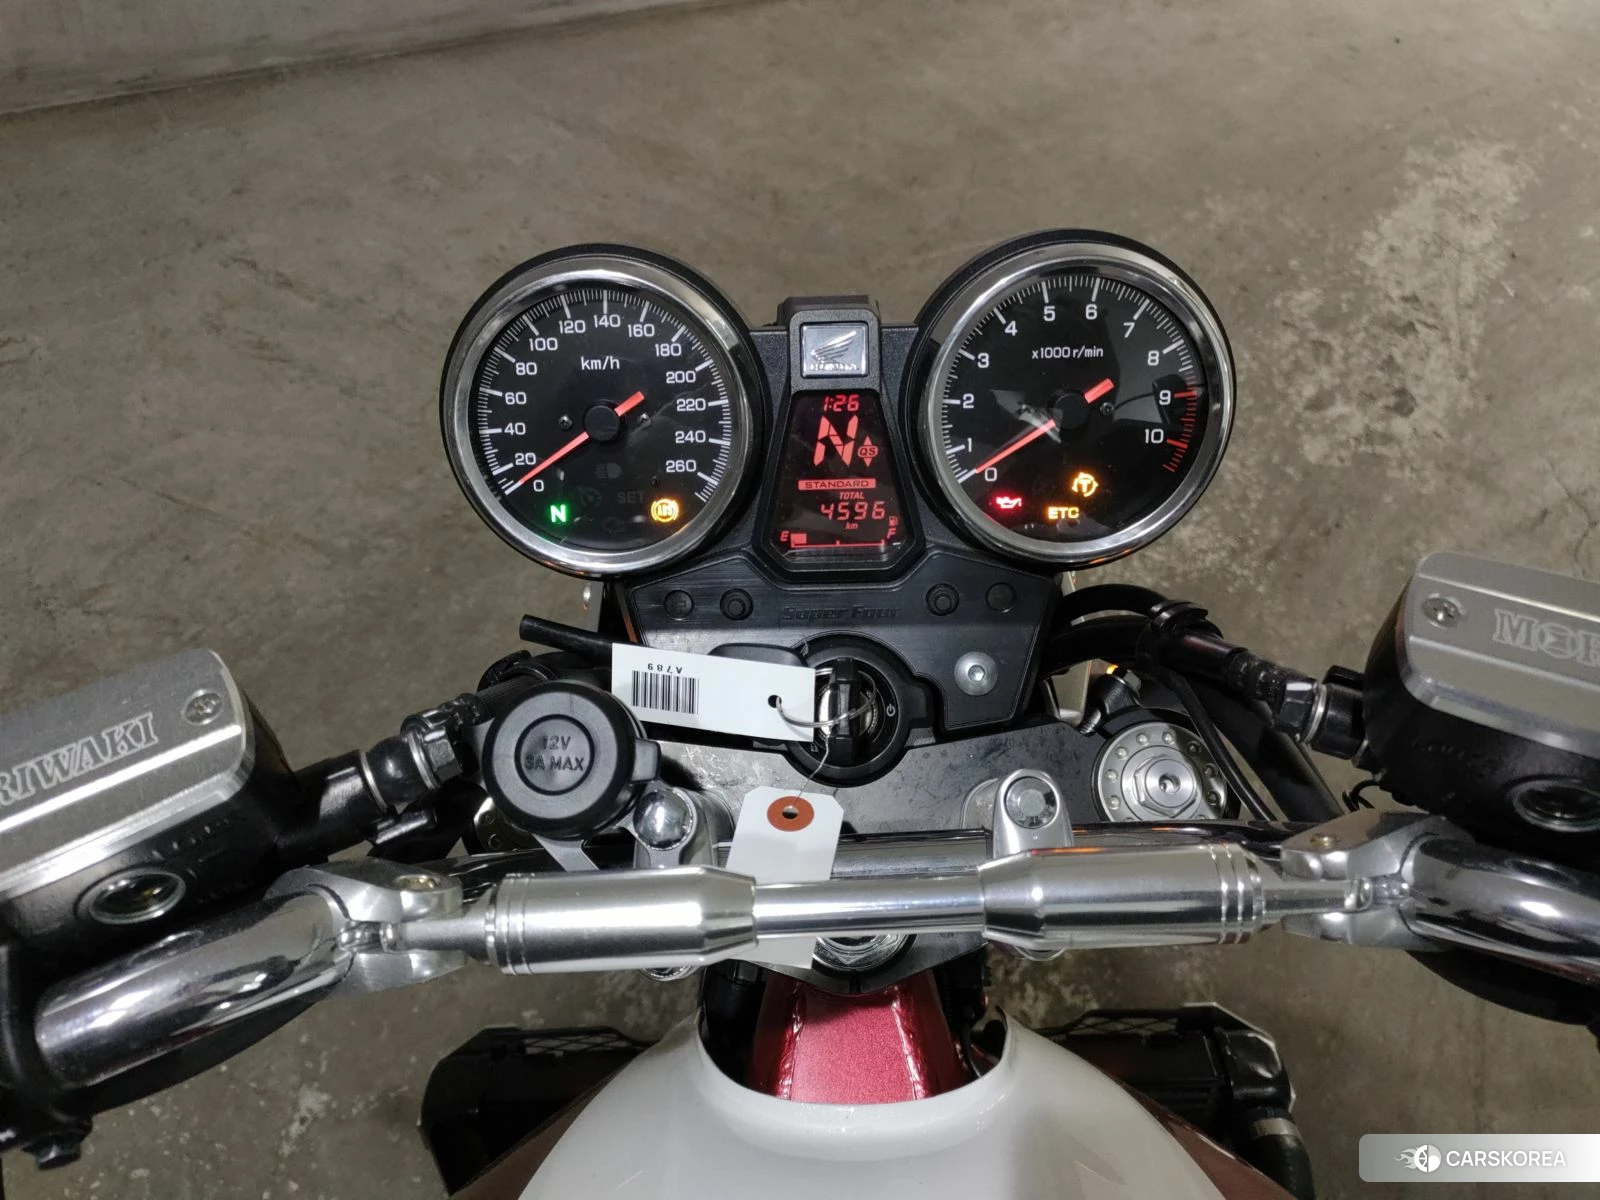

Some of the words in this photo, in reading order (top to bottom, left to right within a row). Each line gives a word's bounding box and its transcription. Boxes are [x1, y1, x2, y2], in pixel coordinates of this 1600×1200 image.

[1043, 306, 1056, 321] 5
[1085, 304, 1098, 319] 6
[558, 319, 587, 334] 120
[593, 313, 622, 329] 140
[1004, 321, 1018, 336] 4
[627, 323, 656, 338] 160
[1122, 322, 1136, 338] 7
[529, 337, 558, 351] 100
[654, 343, 682, 357] 180
[1031, 346, 1072, 360] x1000
[1072, 345, 1104, 359] r/min
[1147, 351, 1160, 366] 8
[580, 356, 621, 370] km/h
[977, 353, 990, 368] 3
[515, 361, 538, 376] 80
[665, 370, 697, 384] 200
[504, 392, 527, 405] 60
[676, 398, 706, 412] 220
[823, 394, 860, 412] 1:26
[962, 394, 975, 409] 2
[1158, 390, 1172, 405] 9
[504, 422, 526, 436] 40
[1144, 428, 1164, 444] 10
[675, 430, 706, 444] 240
[813, 414, 859, 467] N
[966, 437, 973, 452] 1
[514, 452, 536, 466] 20
[858, 446, 877, 457] QS
[665, 459, 697, 474] 260
[985, 467, 997, 482] 0
[533, 479, 545, 492] 0
[804, 479, 869, 489] STANDARD
[838, 491, 865, 500] TOTAL
[550, 504, 567, 523] N
[820, 501, 886, 521] 4596
[1047, 506, 1080, 520] ETC
[845, 521, 859, 530] km
[779, 531, 789, 542] E
[886, 528, 897, 539] F
[782, 606, 847, 622] Super
[647, 662, 683, 674] A789
[542, 735, 571, 750] 12V
[549, 755, 584, 771] MAX
